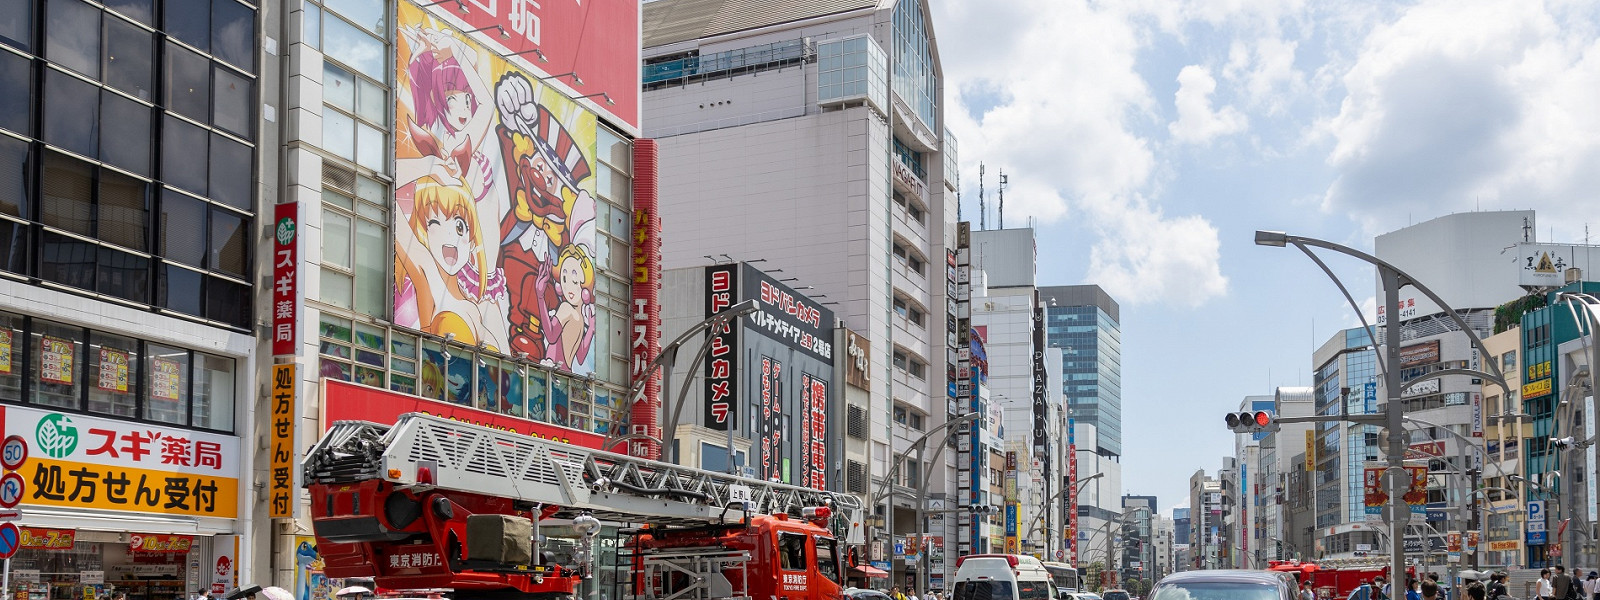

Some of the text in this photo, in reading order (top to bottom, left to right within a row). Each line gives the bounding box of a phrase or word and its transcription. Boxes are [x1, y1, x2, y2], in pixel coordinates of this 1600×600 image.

[472, 0, 541, 46] 拓
[635, 209, 649, 283] パチンコ
[276, 249, 294, 343] スギ薬局
[760, 279, 821, 329] ヨドバシカメラ
[1378, 298, 1415, 314] 広募集
[633, 298, 649, 405] エスパス
[849, 333, 870, 381] みはし
[1034, 350, 1043, 406] PLAZA
[5, 444, 21, 461] 50
[86, 428, 222, 470] スギ薬局
[272, 367, 292, 516] 処方せん受付
[33, 462, 218, 512] 処方せん受付
[1529, 503, 1539, 519] P
